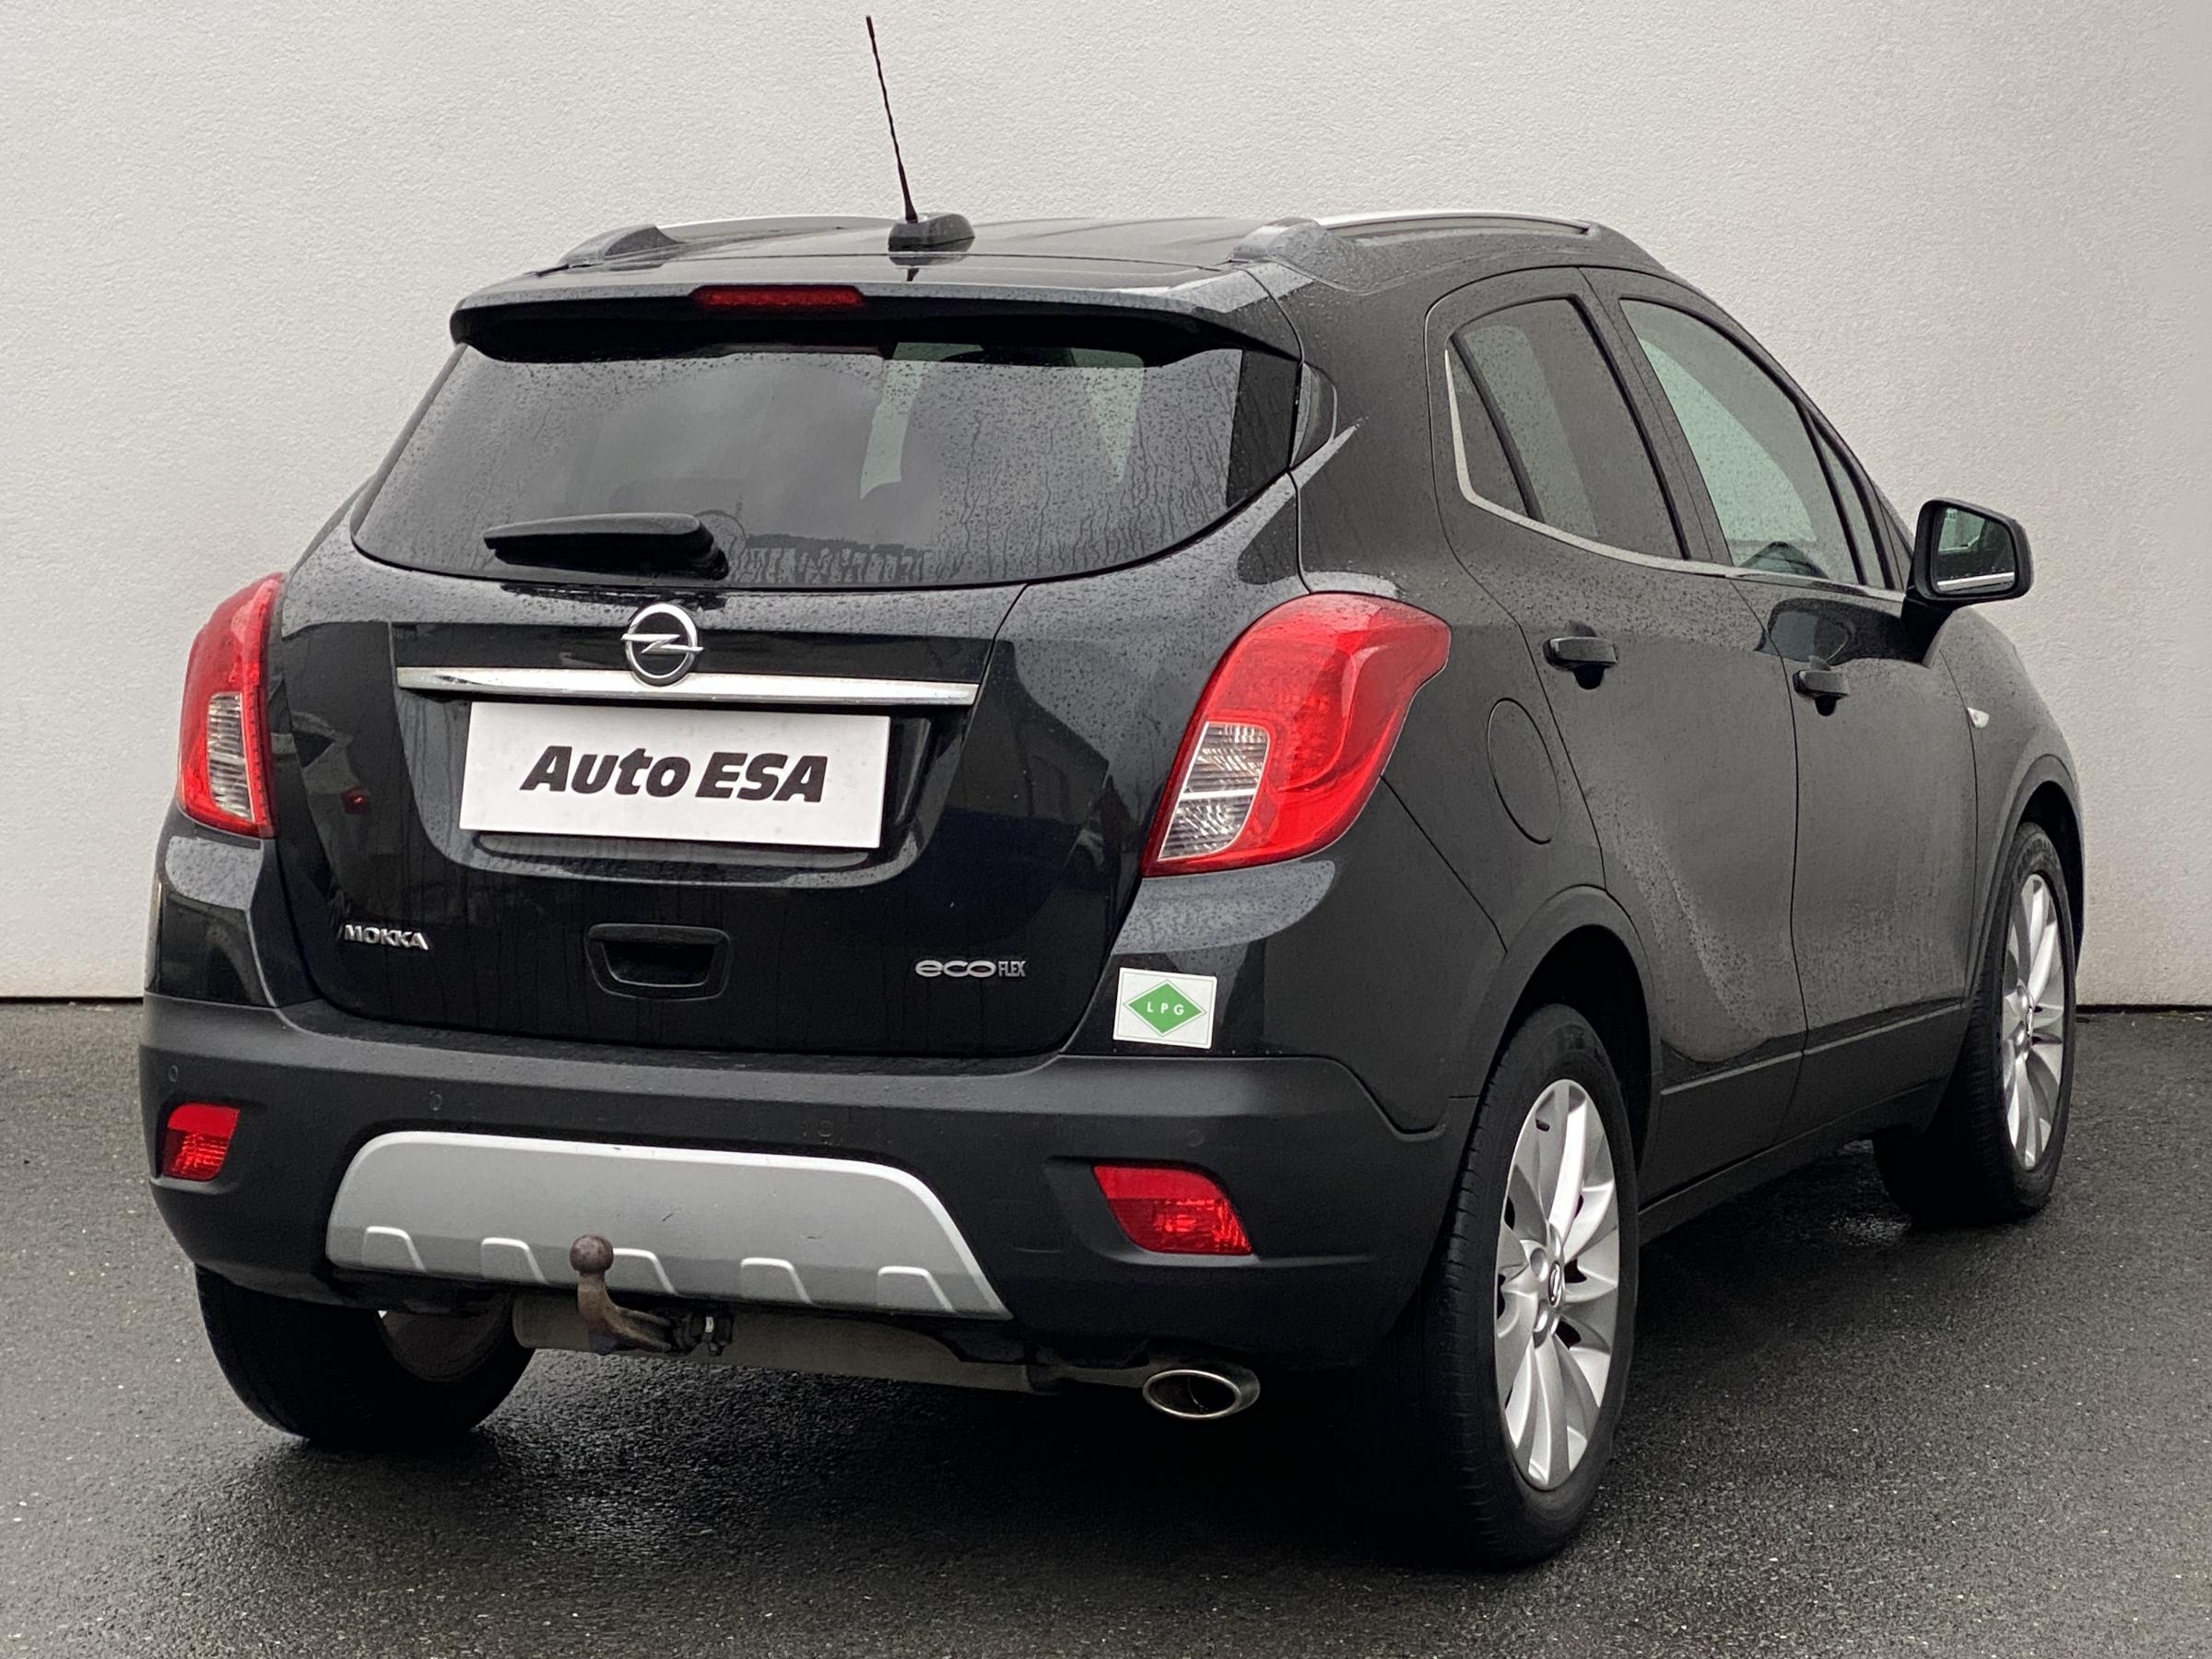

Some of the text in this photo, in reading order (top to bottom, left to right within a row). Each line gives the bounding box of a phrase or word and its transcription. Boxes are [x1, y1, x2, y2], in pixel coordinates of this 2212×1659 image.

[519, 745, 828, 803] Auto ESA
[344, 924, 429, 950] MOKKA
